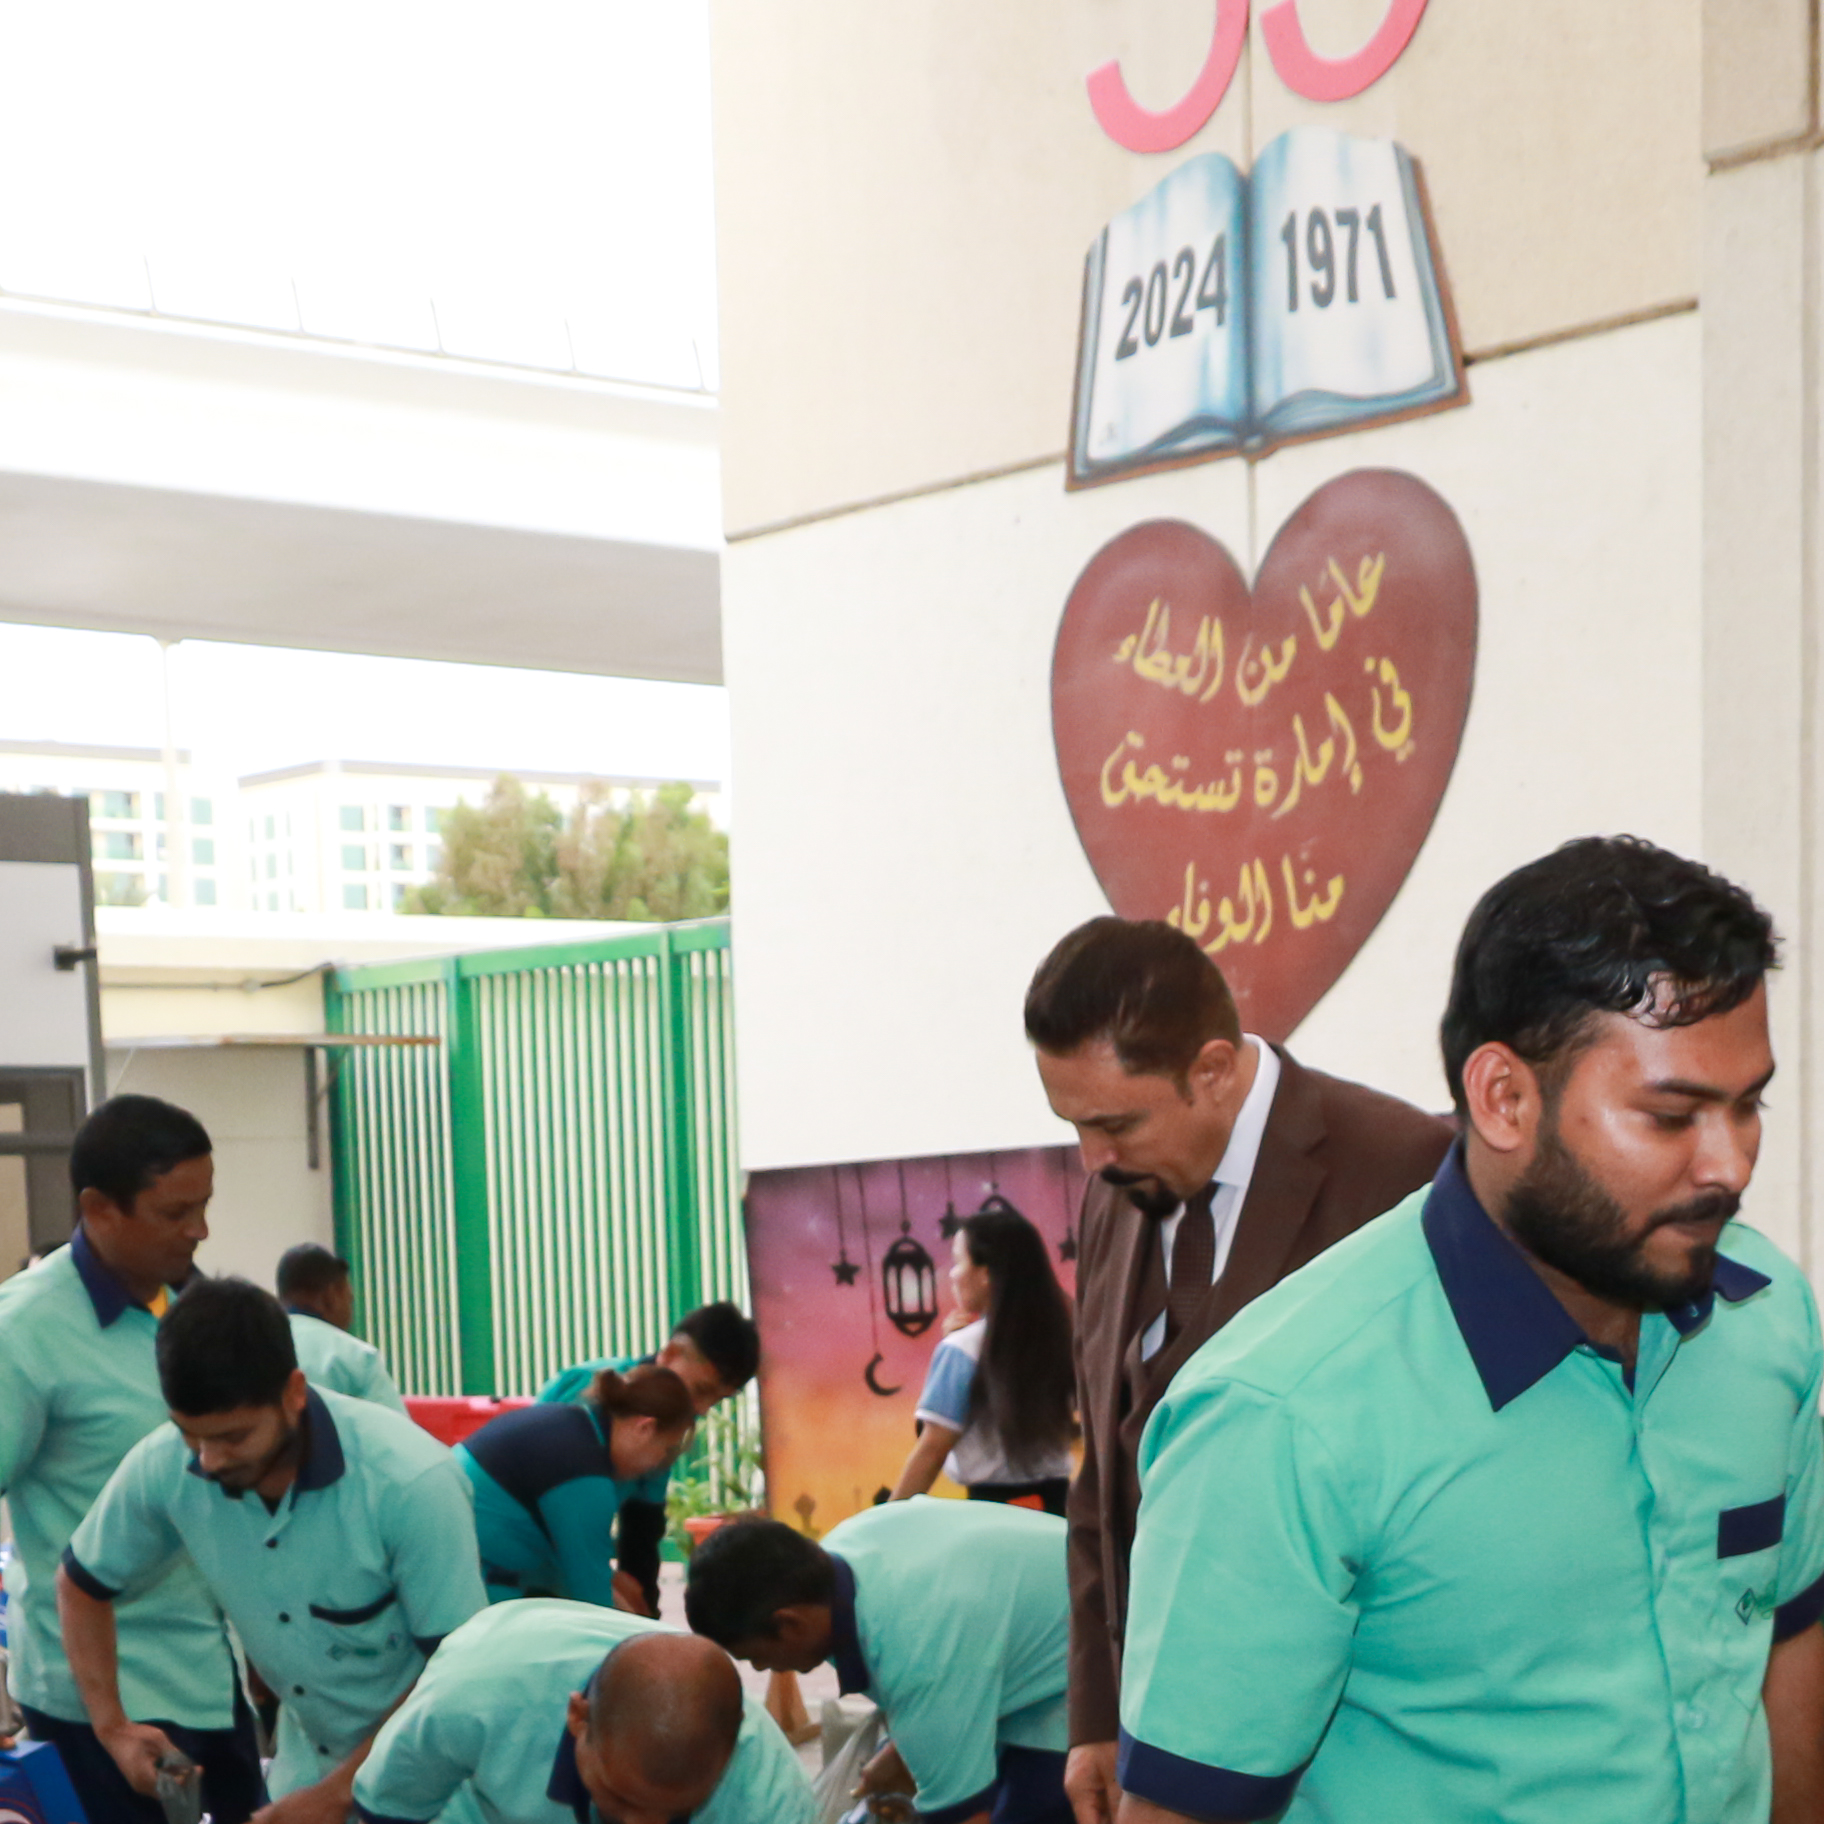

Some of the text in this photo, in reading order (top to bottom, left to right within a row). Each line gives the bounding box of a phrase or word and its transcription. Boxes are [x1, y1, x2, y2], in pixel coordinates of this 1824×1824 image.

[1115, 232, 1227, 361] 2024
[1281, 204, 1396, 312] 1971
[1113, 597, 1225, 703] العطاء
[1235, 633, 1298, 707] من
[1364, 656, 1416, 762] في
[1100, 731, 1243, 812] تستحق
